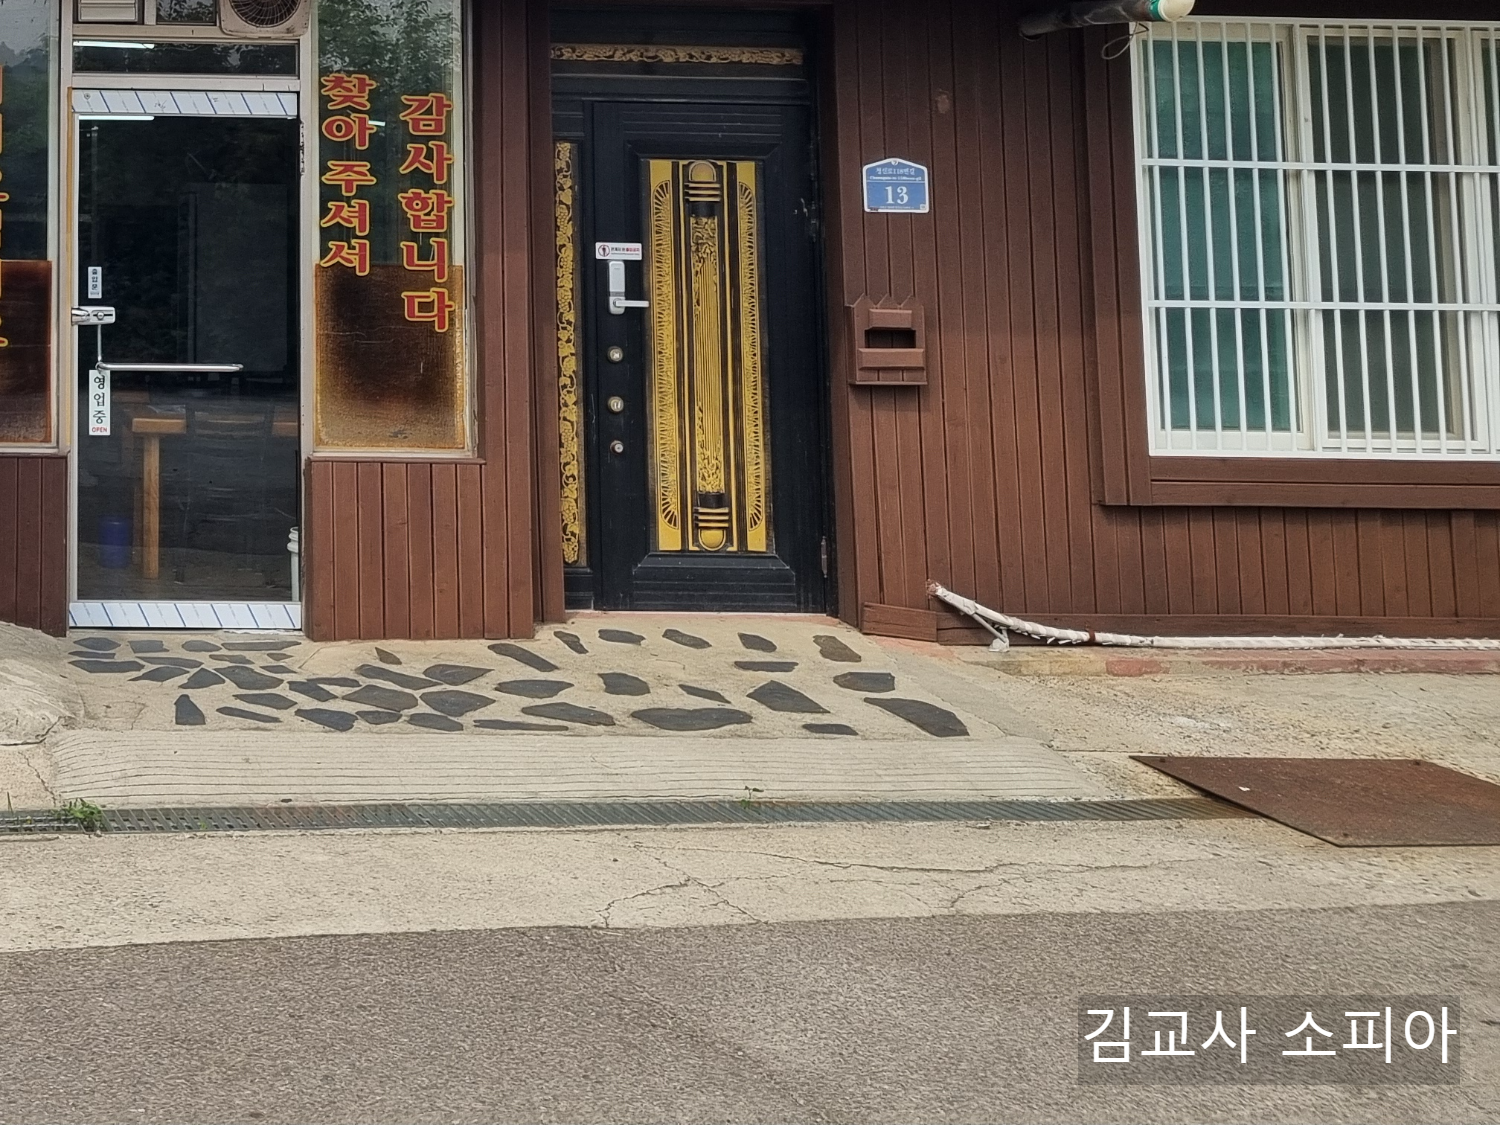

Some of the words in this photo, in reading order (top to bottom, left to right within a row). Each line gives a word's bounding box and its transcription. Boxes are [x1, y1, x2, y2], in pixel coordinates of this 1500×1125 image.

[398, 92, 455, 333] 감사합니다
[885, 185, 909, 205] 13
[93, 374, 107, 424] 영업중
